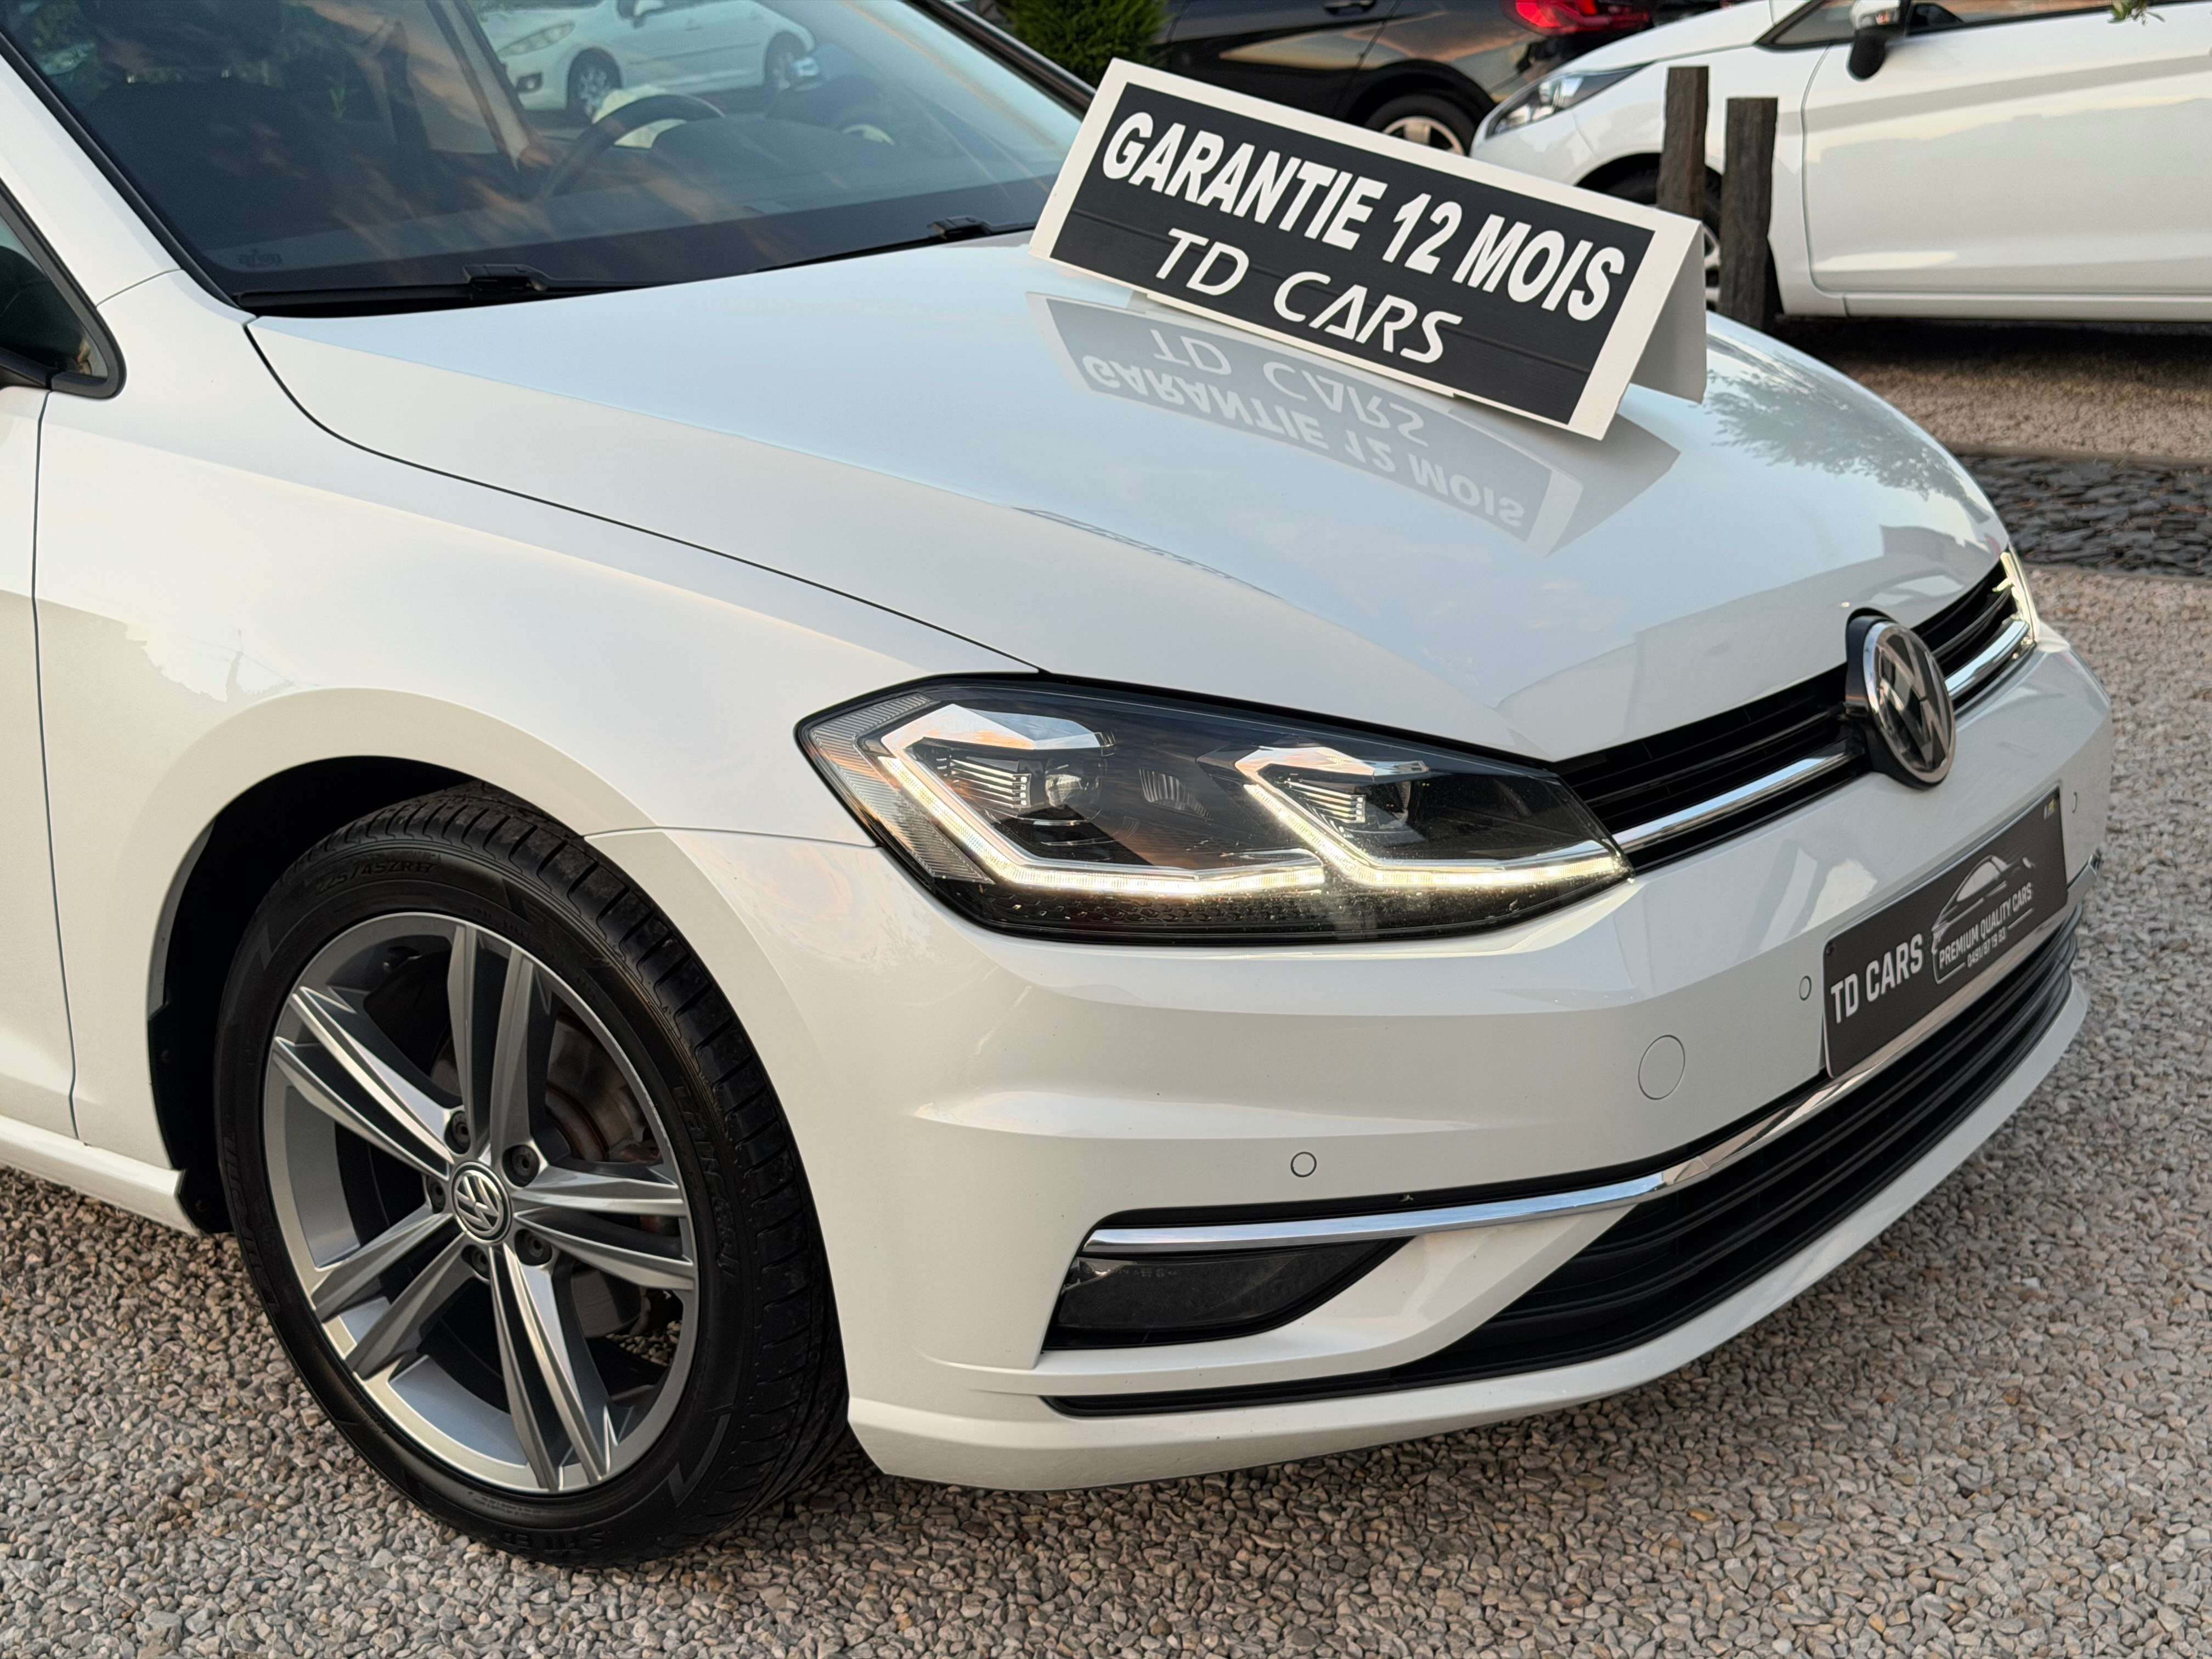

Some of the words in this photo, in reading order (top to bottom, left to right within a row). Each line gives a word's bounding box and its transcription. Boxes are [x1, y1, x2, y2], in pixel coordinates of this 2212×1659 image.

[1102, 111, 1389, 251] GARANTIE
[1381, 193, 1463, 274] 12
[1452, 213, 1625, 321] MOIS
[1155, 227, 1250, 296] TD
[1273, 271, 1463, 364] CARS
[1830, 973, 1859, 1024] TD
[1866, 934, 1923, 1003] CARS
[1939, 924, 1979, 969] PREMIUM
[1980, 898, 2012, 940] QUALITY
[2012, 882, 2033, 912] CARS
